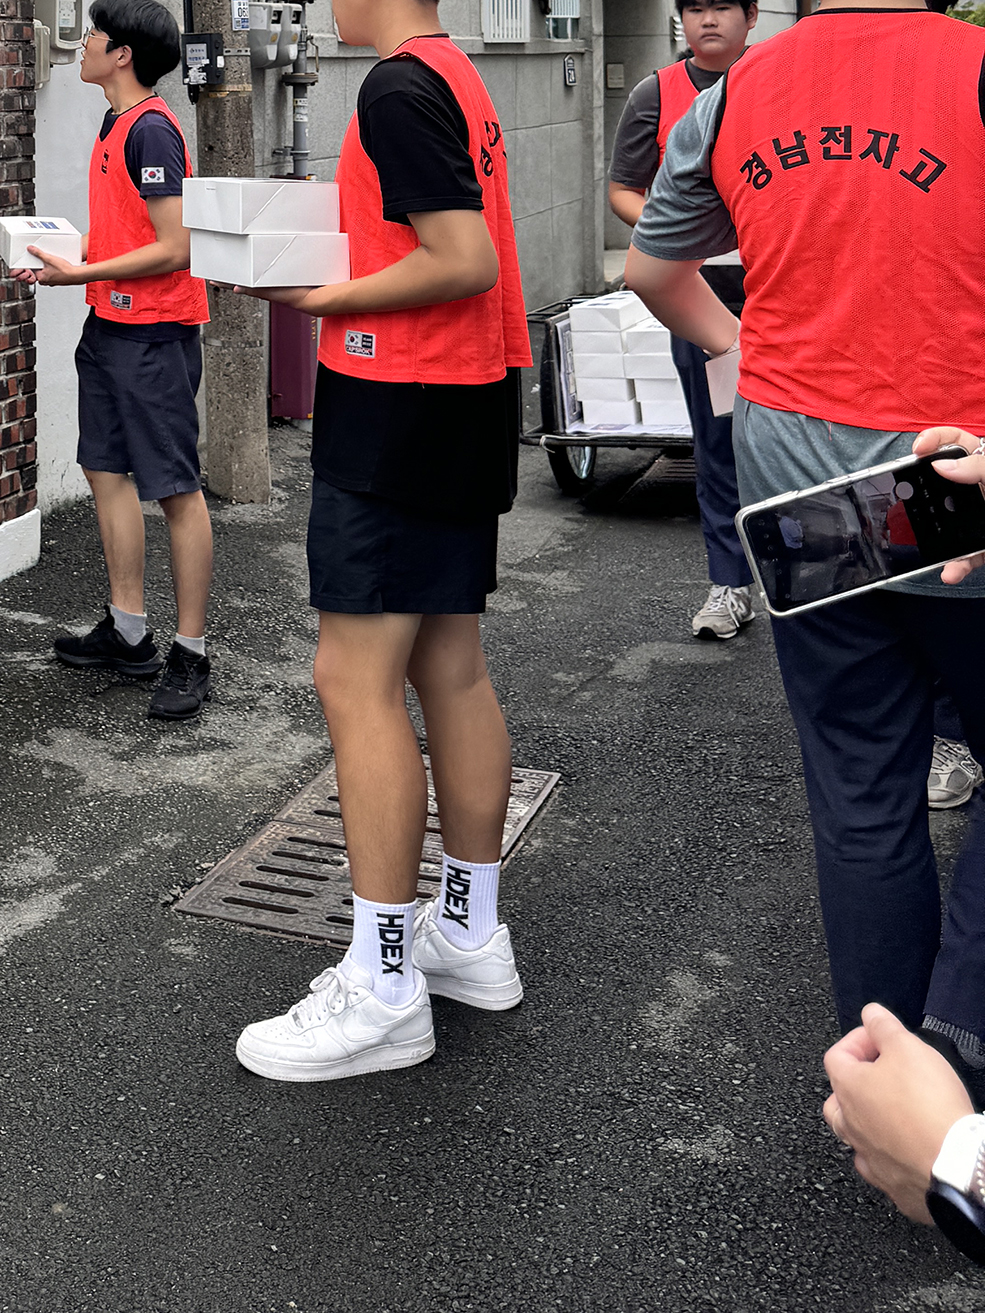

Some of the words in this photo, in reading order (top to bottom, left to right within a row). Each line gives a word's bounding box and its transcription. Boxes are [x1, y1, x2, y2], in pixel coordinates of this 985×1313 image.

[739, 125, 948, 194] 경남전자고
[442, 864, 472, 931] HDEX
[376, 912, 405, 977] HDEX
